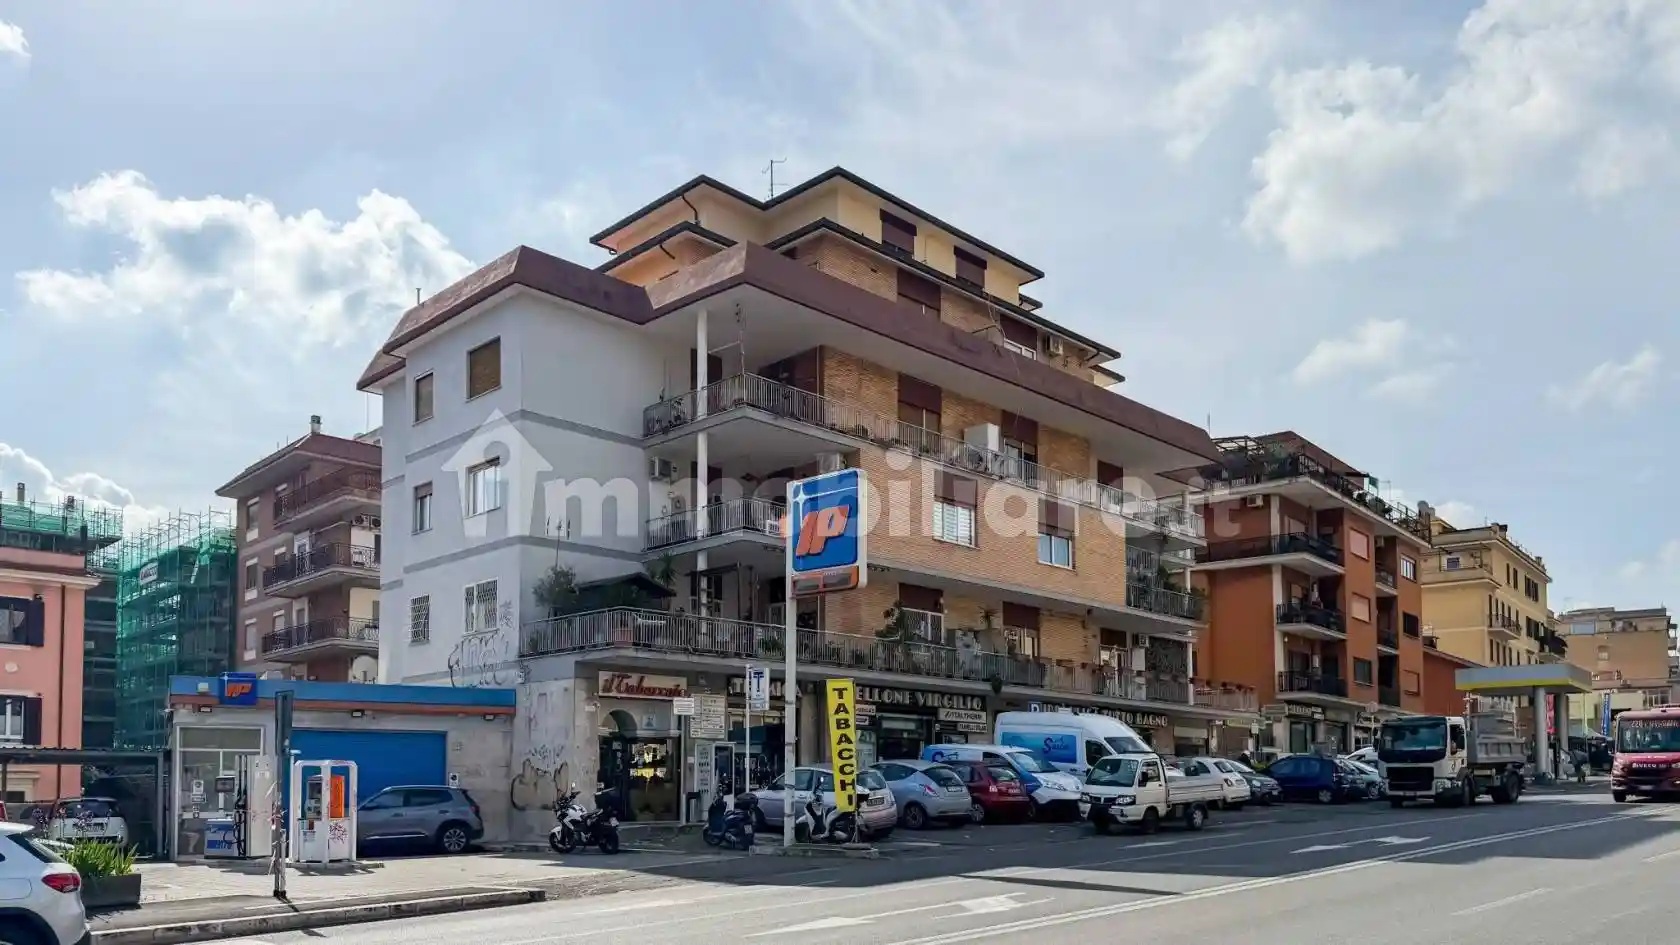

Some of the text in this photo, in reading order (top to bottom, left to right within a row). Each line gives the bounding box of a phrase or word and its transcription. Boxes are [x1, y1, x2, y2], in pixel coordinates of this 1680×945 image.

[855, 686, 982, 710] ELLONE VIRGILIO
[1137, 713, 1168, 727] BAGNO
[832, 688, 855, 806] TABACCHI
